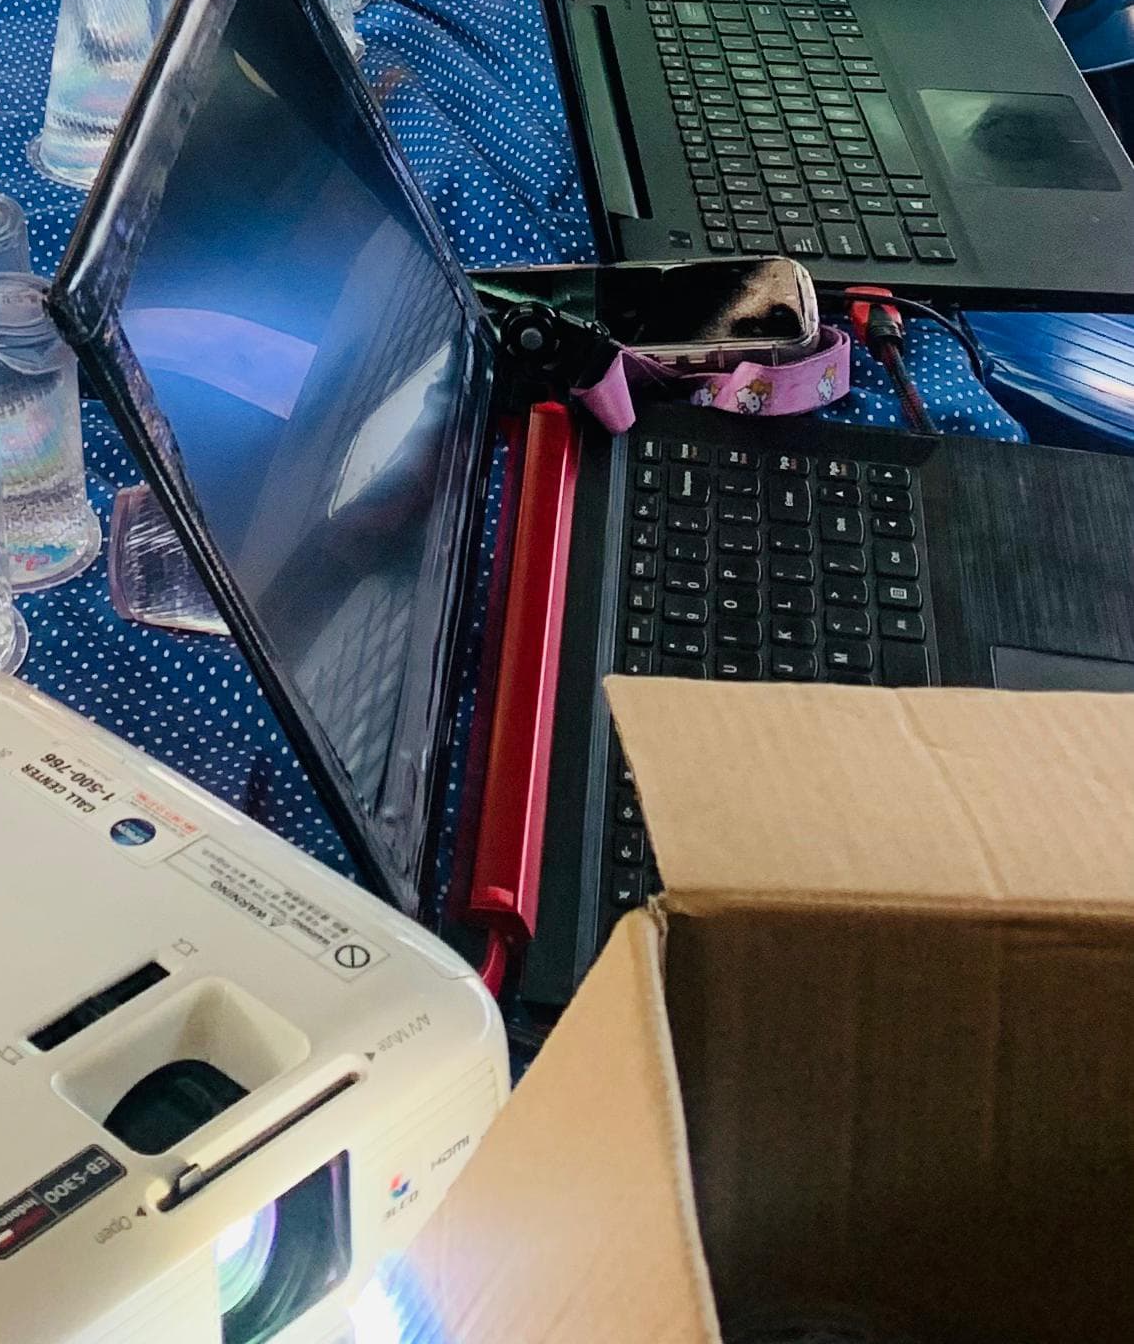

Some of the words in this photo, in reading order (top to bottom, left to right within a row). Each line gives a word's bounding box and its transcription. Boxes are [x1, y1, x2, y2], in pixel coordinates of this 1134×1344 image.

[20, 763, 67, 795] CENTER
[40, 752, 116, 802] 1-500-766
[66, 791, 97, 814] CALL
[210, 878, 268, 921] WARNING
[43, 1155, 111, 1204] EB-S300
